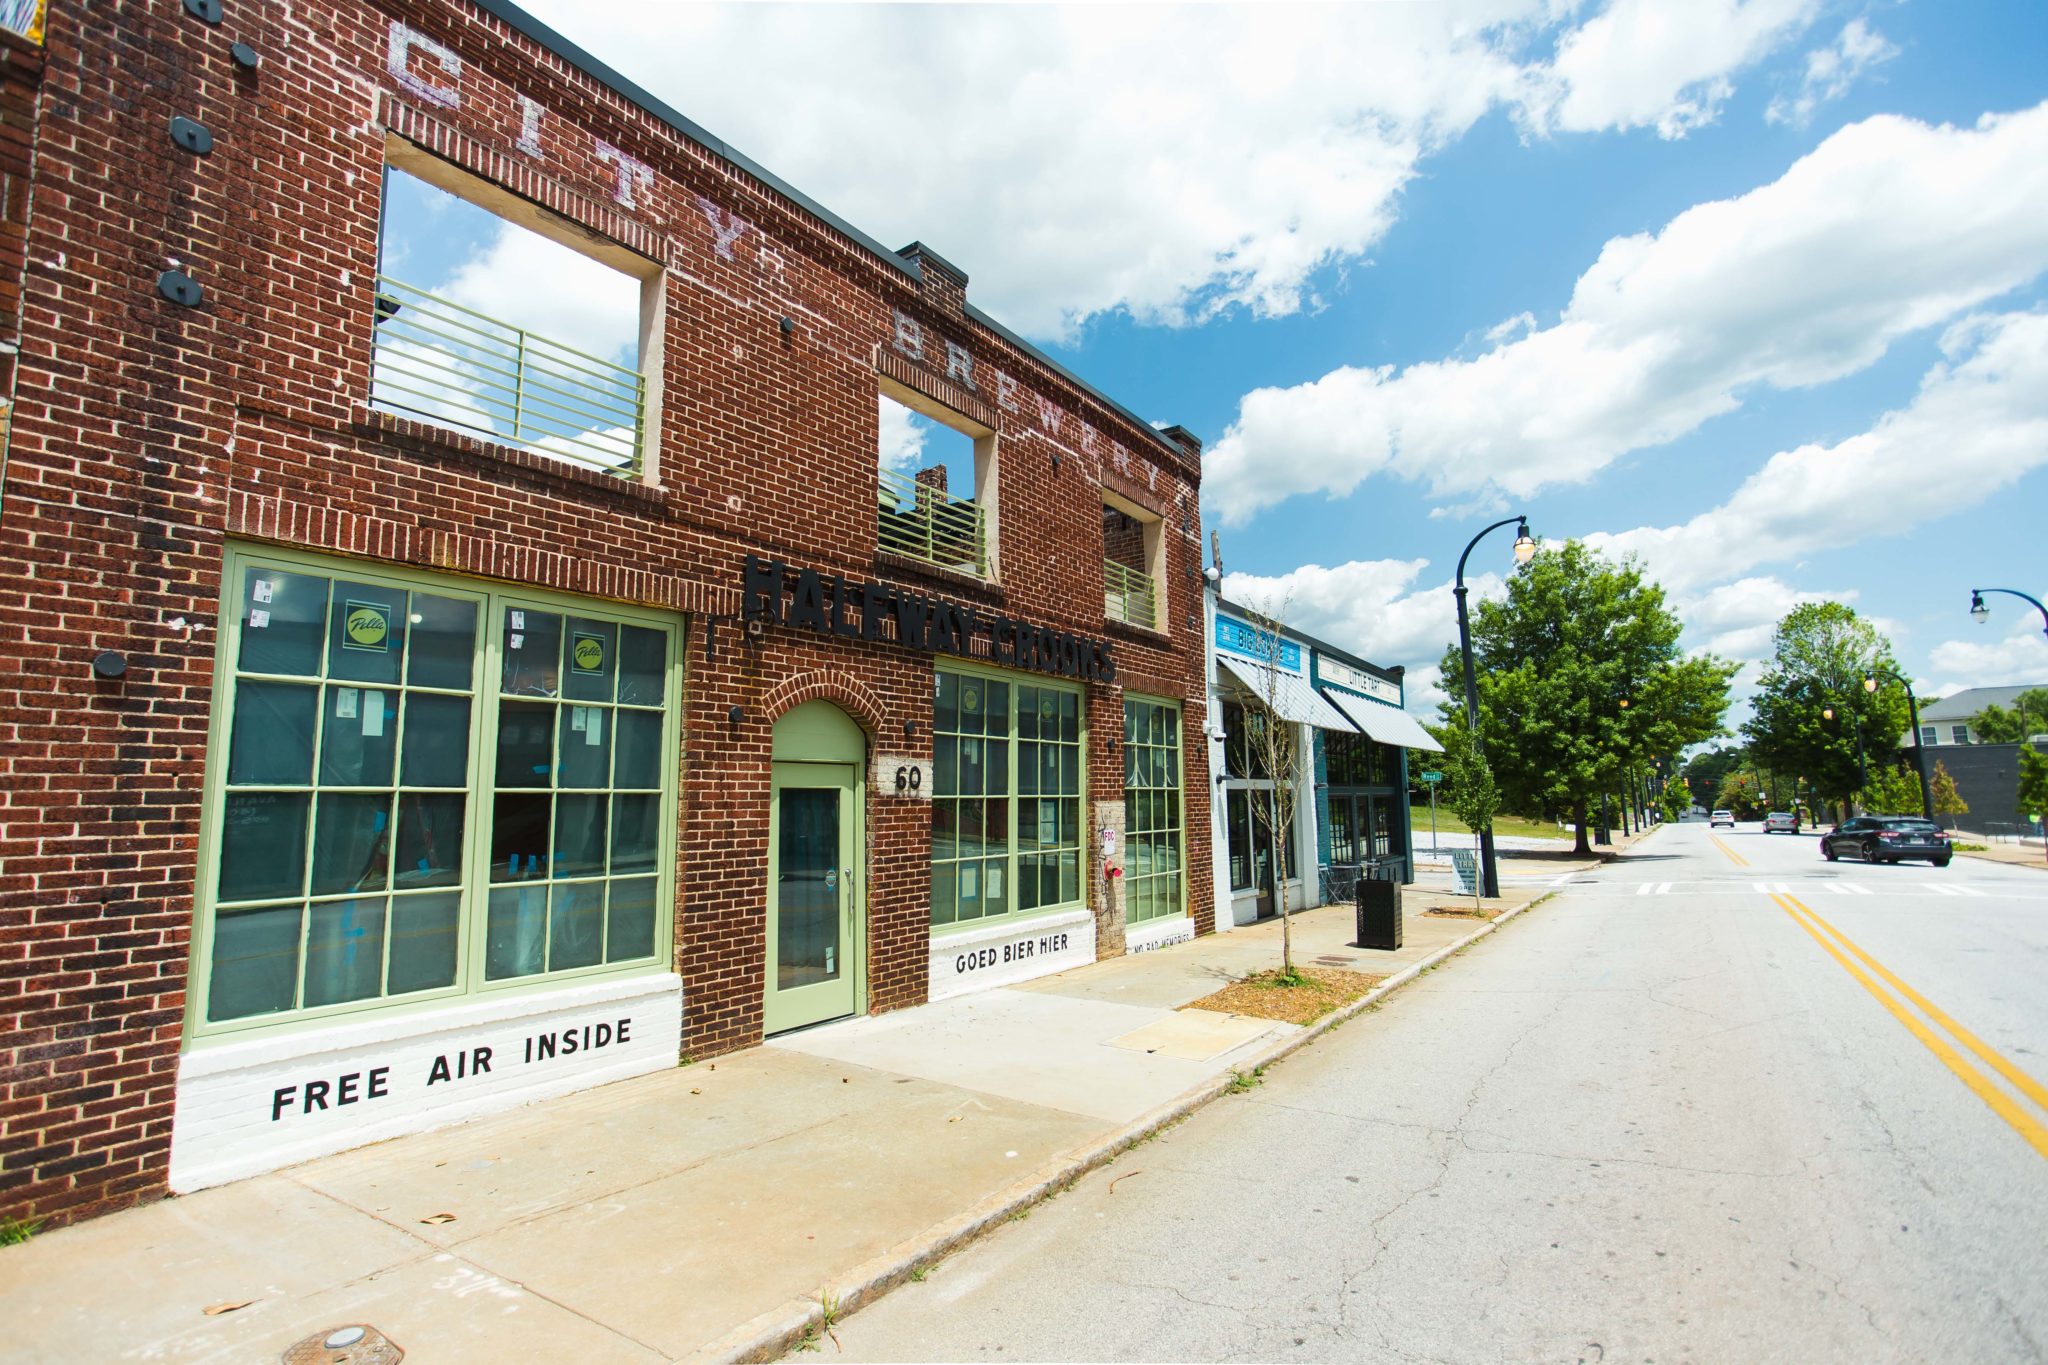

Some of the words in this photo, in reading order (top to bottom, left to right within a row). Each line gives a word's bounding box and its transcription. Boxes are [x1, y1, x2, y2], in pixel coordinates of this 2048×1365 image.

[388, 20, 745, 262] CITY
[891, 308, 1160, 492] BREWERY
[350, 617, 384, 633] Pella
[744, 554, 978, 657] HALFWAY
[993, 615, 1118, 684] CROOKS
[1238, 629, 1253, 651] BIG
[576, 646, 601, 660] Pella
[1349, 669, 1367, 690] LITTLE
[1368, 677, 1380, 694] TART
[896, 766, 921, 790] 60
[1104, 831, 1115, 841] FDC
[956, 948, 997, 974] GOED
[1003, 940, 1034, 963] BIER
[1040, 933, 1068, 955] HIER
[1134, 944, 1144, 953] NO
[1146, 940, 1159, 951] BAD
[271, 1066, 391, 1122] FREE
[427, 1046, 493, 1086] AIR
[525, 1018, 632, 1064] INSIDE
